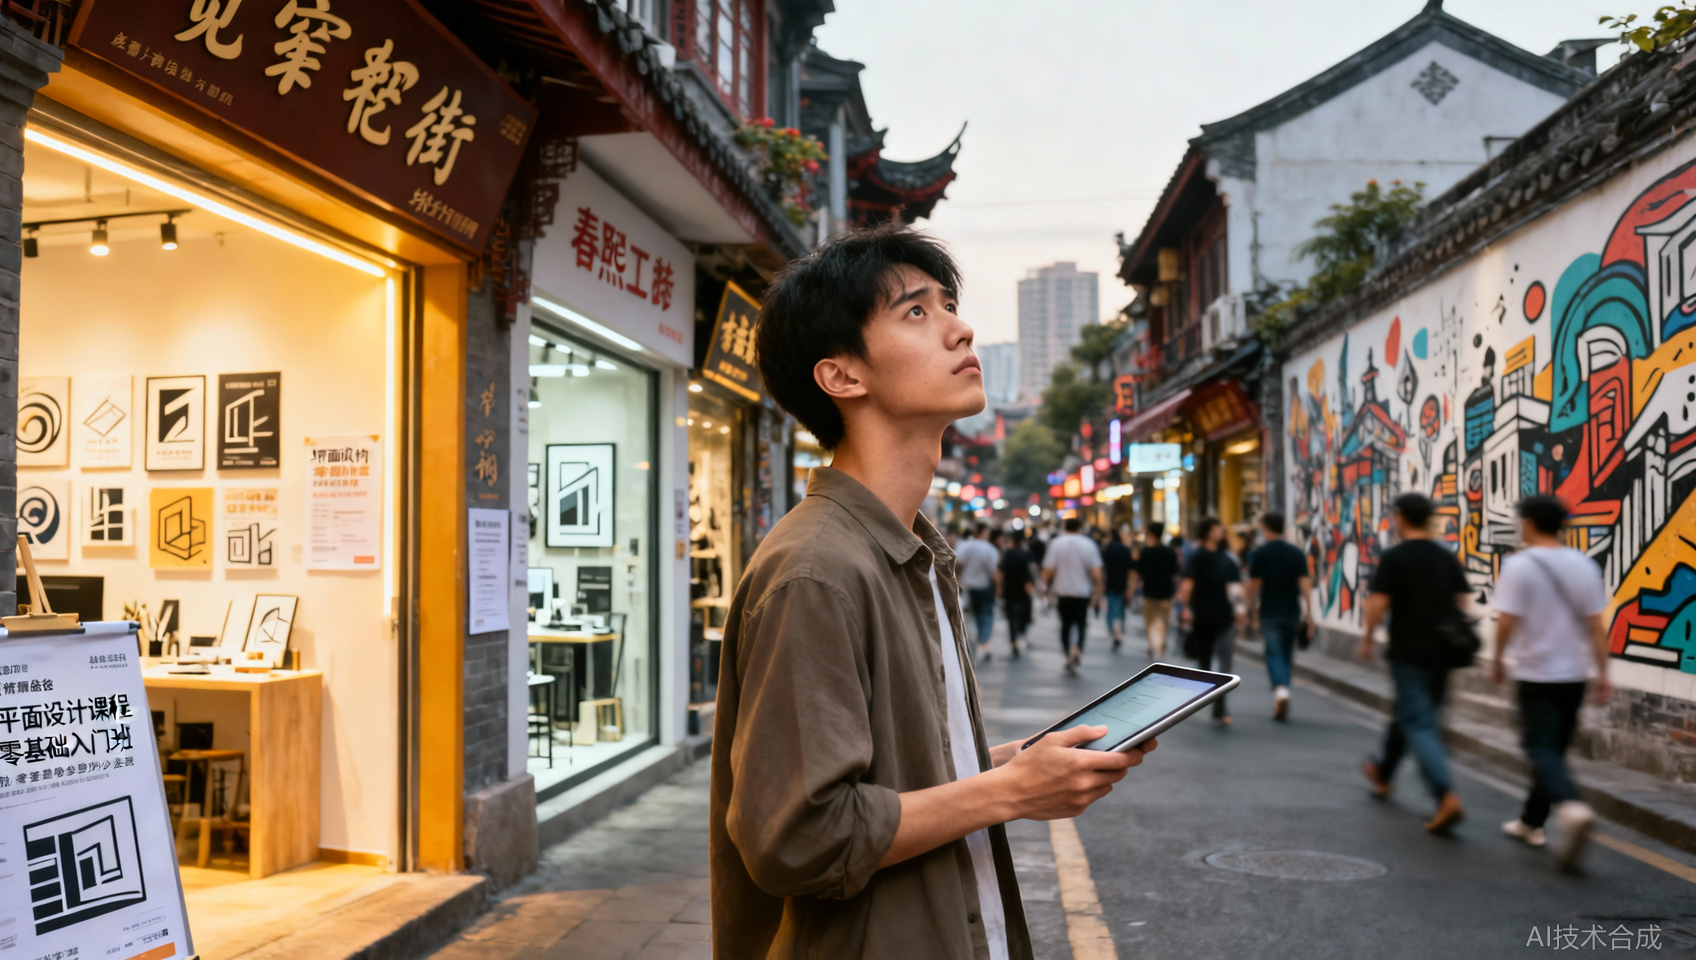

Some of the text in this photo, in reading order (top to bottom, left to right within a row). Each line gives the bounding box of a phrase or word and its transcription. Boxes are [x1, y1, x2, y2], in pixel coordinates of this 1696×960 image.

[0, 694, 133, 733] 平面设计课程
[0, 724, 133, 766] 零基础入门班
